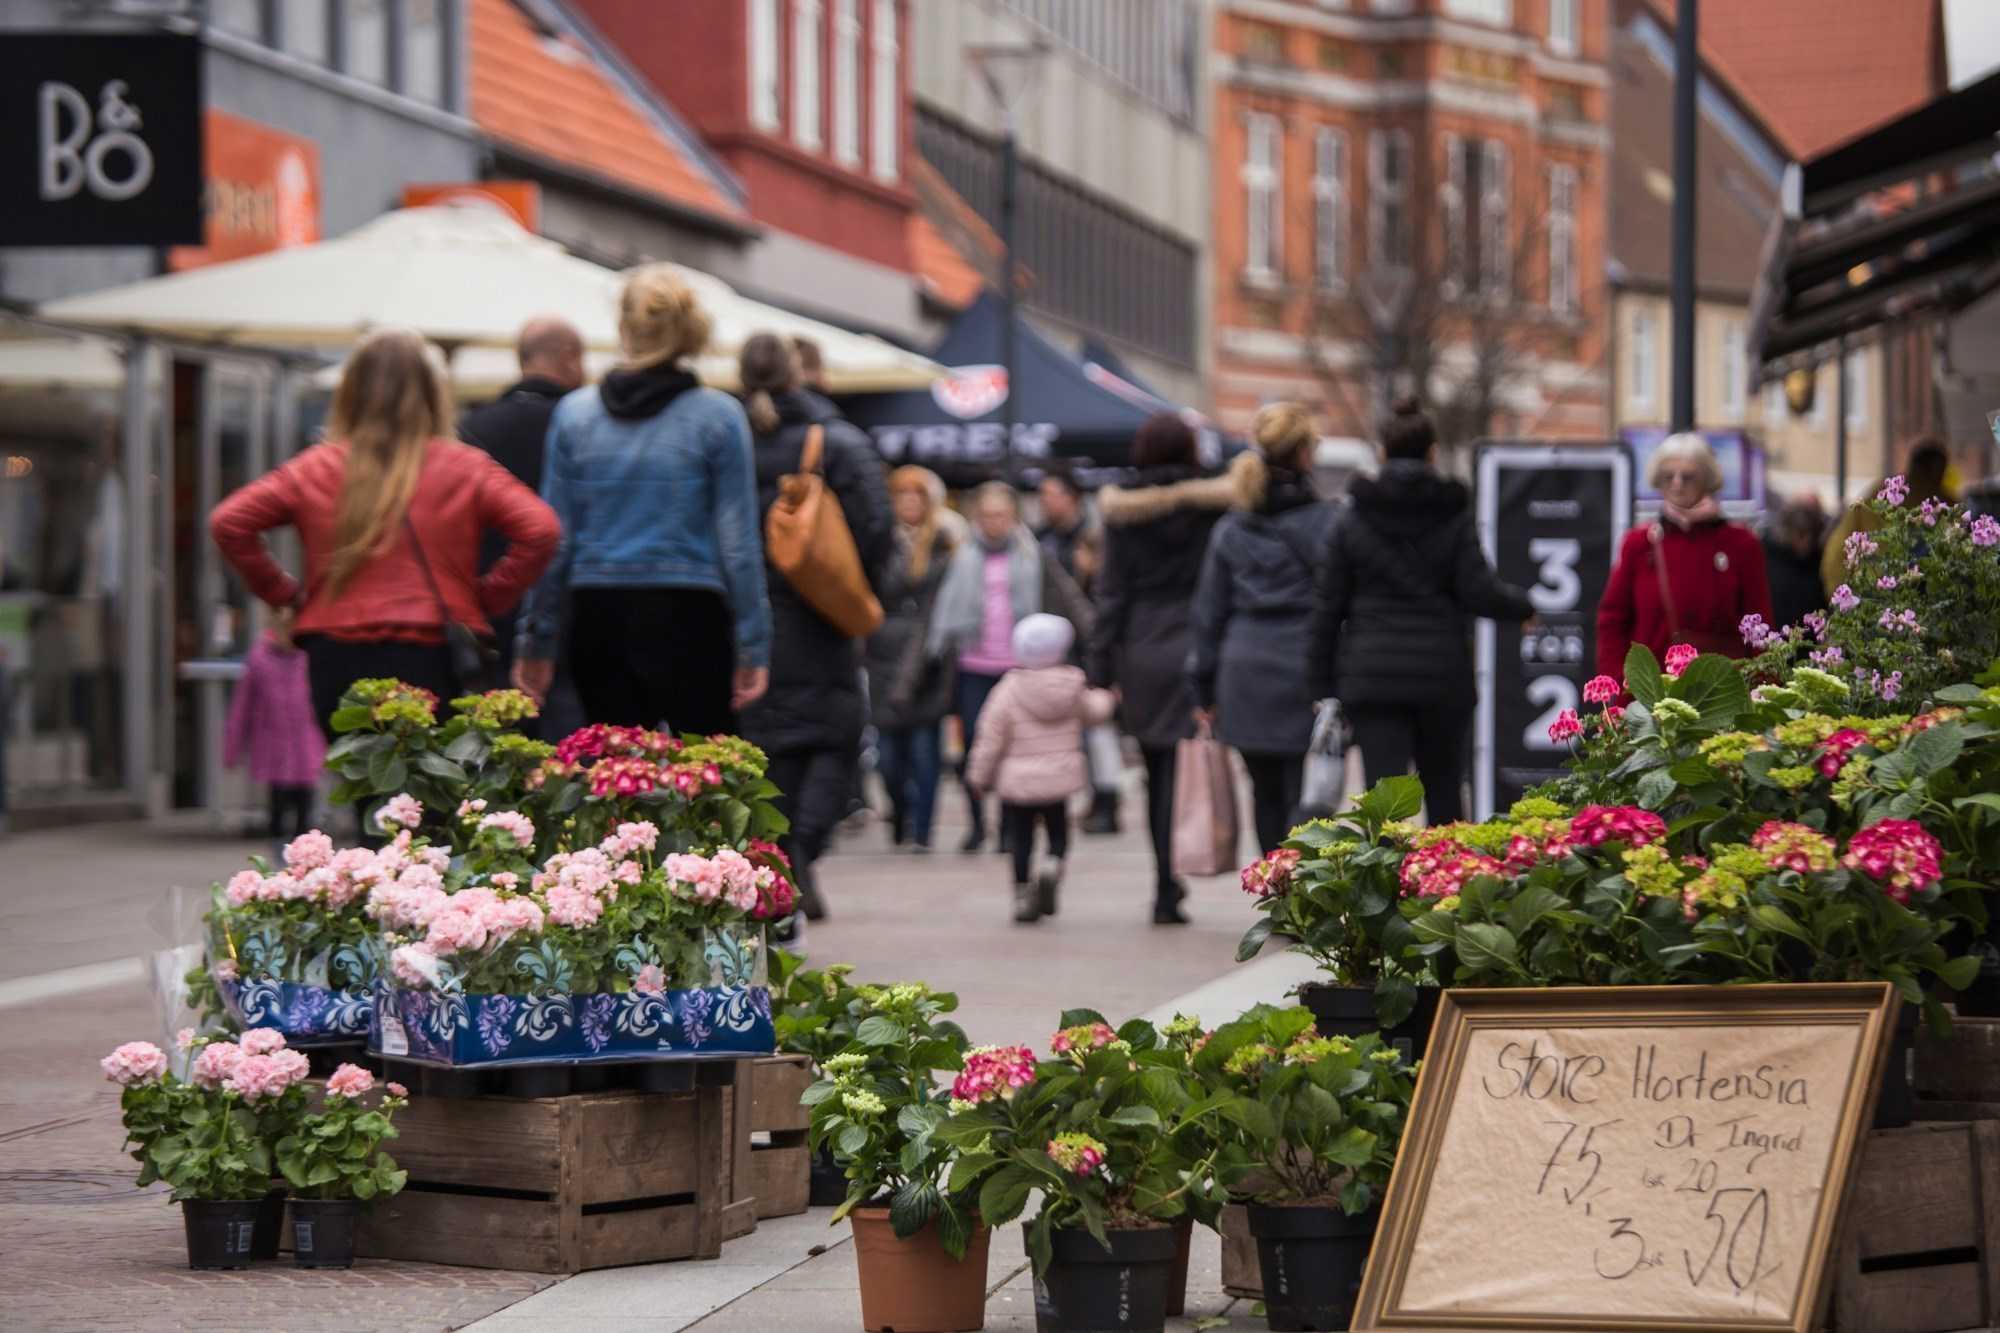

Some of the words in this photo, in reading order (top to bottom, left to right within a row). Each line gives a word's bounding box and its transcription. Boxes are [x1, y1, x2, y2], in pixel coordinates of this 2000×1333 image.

[871, 422, 1060, 460] TREK
[1527, 538, 1582, 613] 3
[1520, 635, 1584, 663] FOR
[1522, 674, 1579, 751] 2
[1714, 1114, 1806, 1174] Ingrid
[1673, 1158, 1718, 1193] 20
